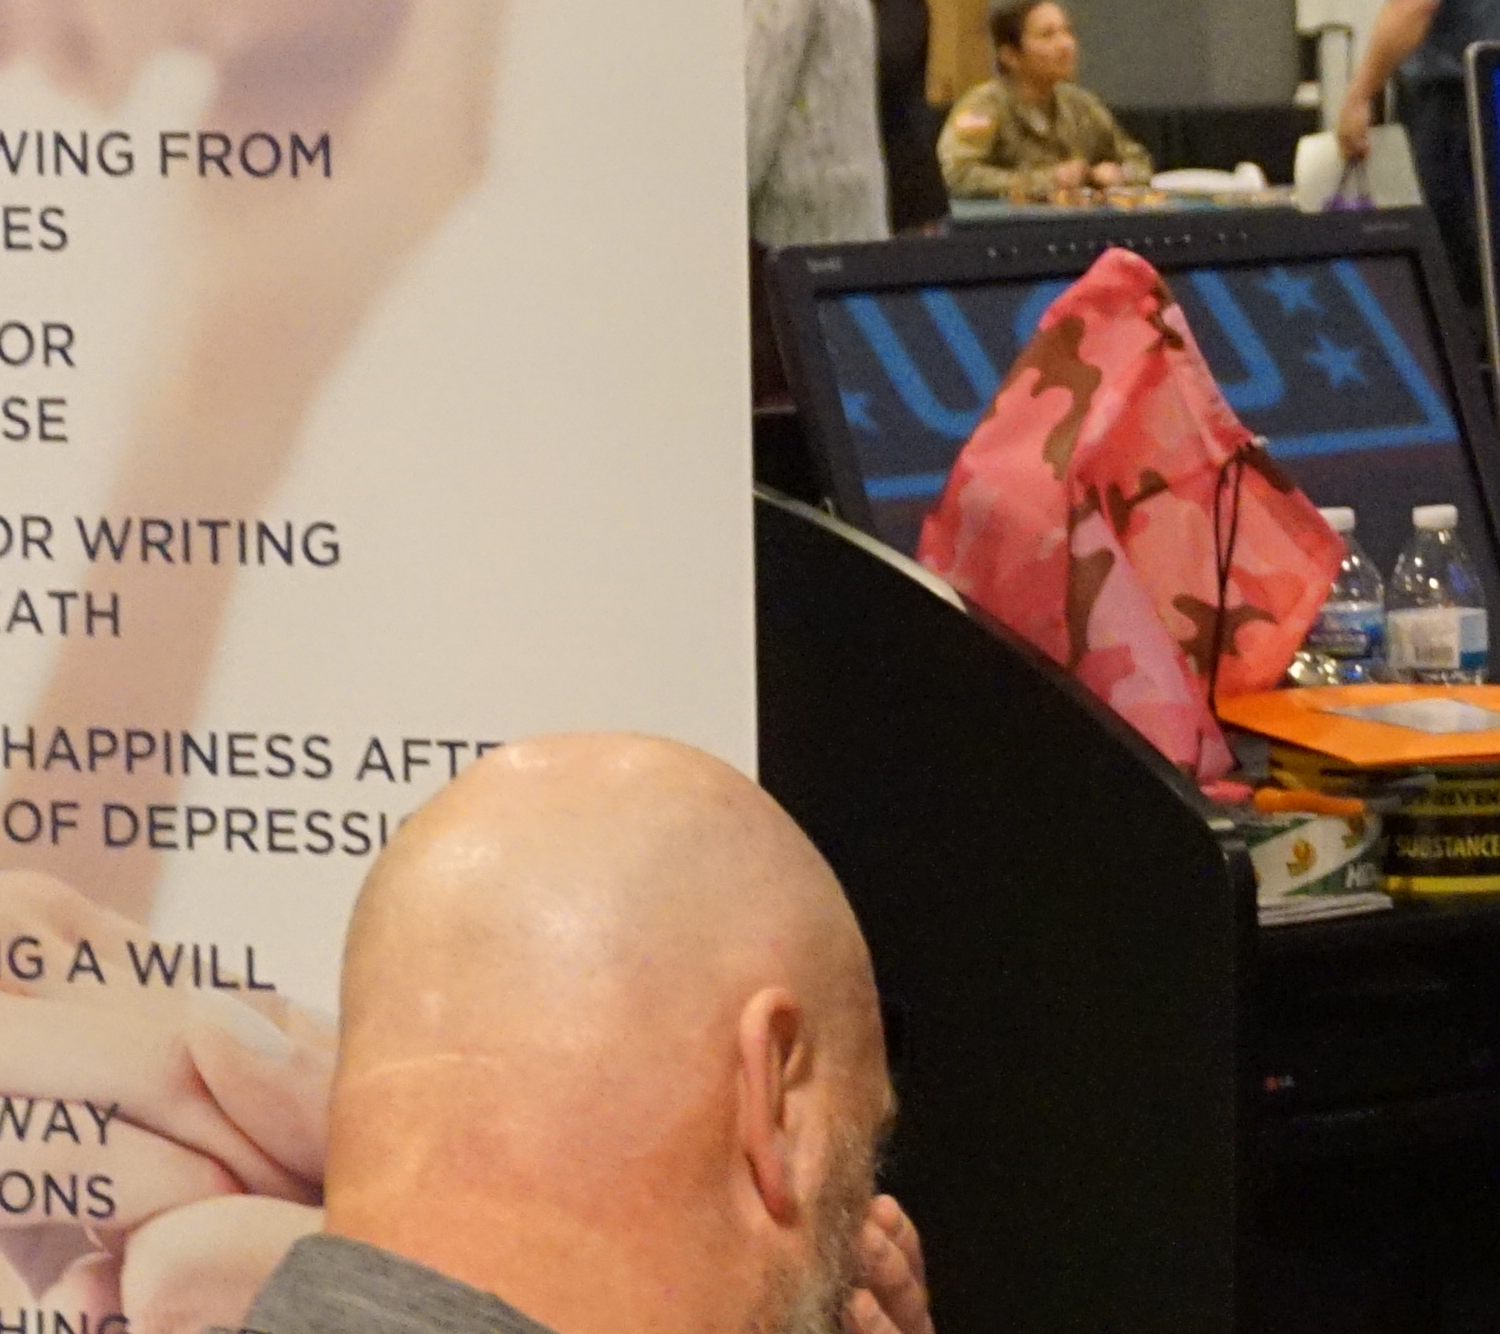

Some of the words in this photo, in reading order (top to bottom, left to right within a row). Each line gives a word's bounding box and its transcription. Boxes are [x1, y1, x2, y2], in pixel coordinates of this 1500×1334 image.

[158, 130, 333, 180] FROM
[74, 516, 341, 569] WRITING
[1, 724, 334, 781] HAPPINESS
[1, 797, 81, 846] OF
[100, 801, 410, 861] DEPRESSI
[1397, 833, 1500, 859] SUBSTANCE
[66, 938, 106, 985] A
[125, 940, 277, 993] WILL
